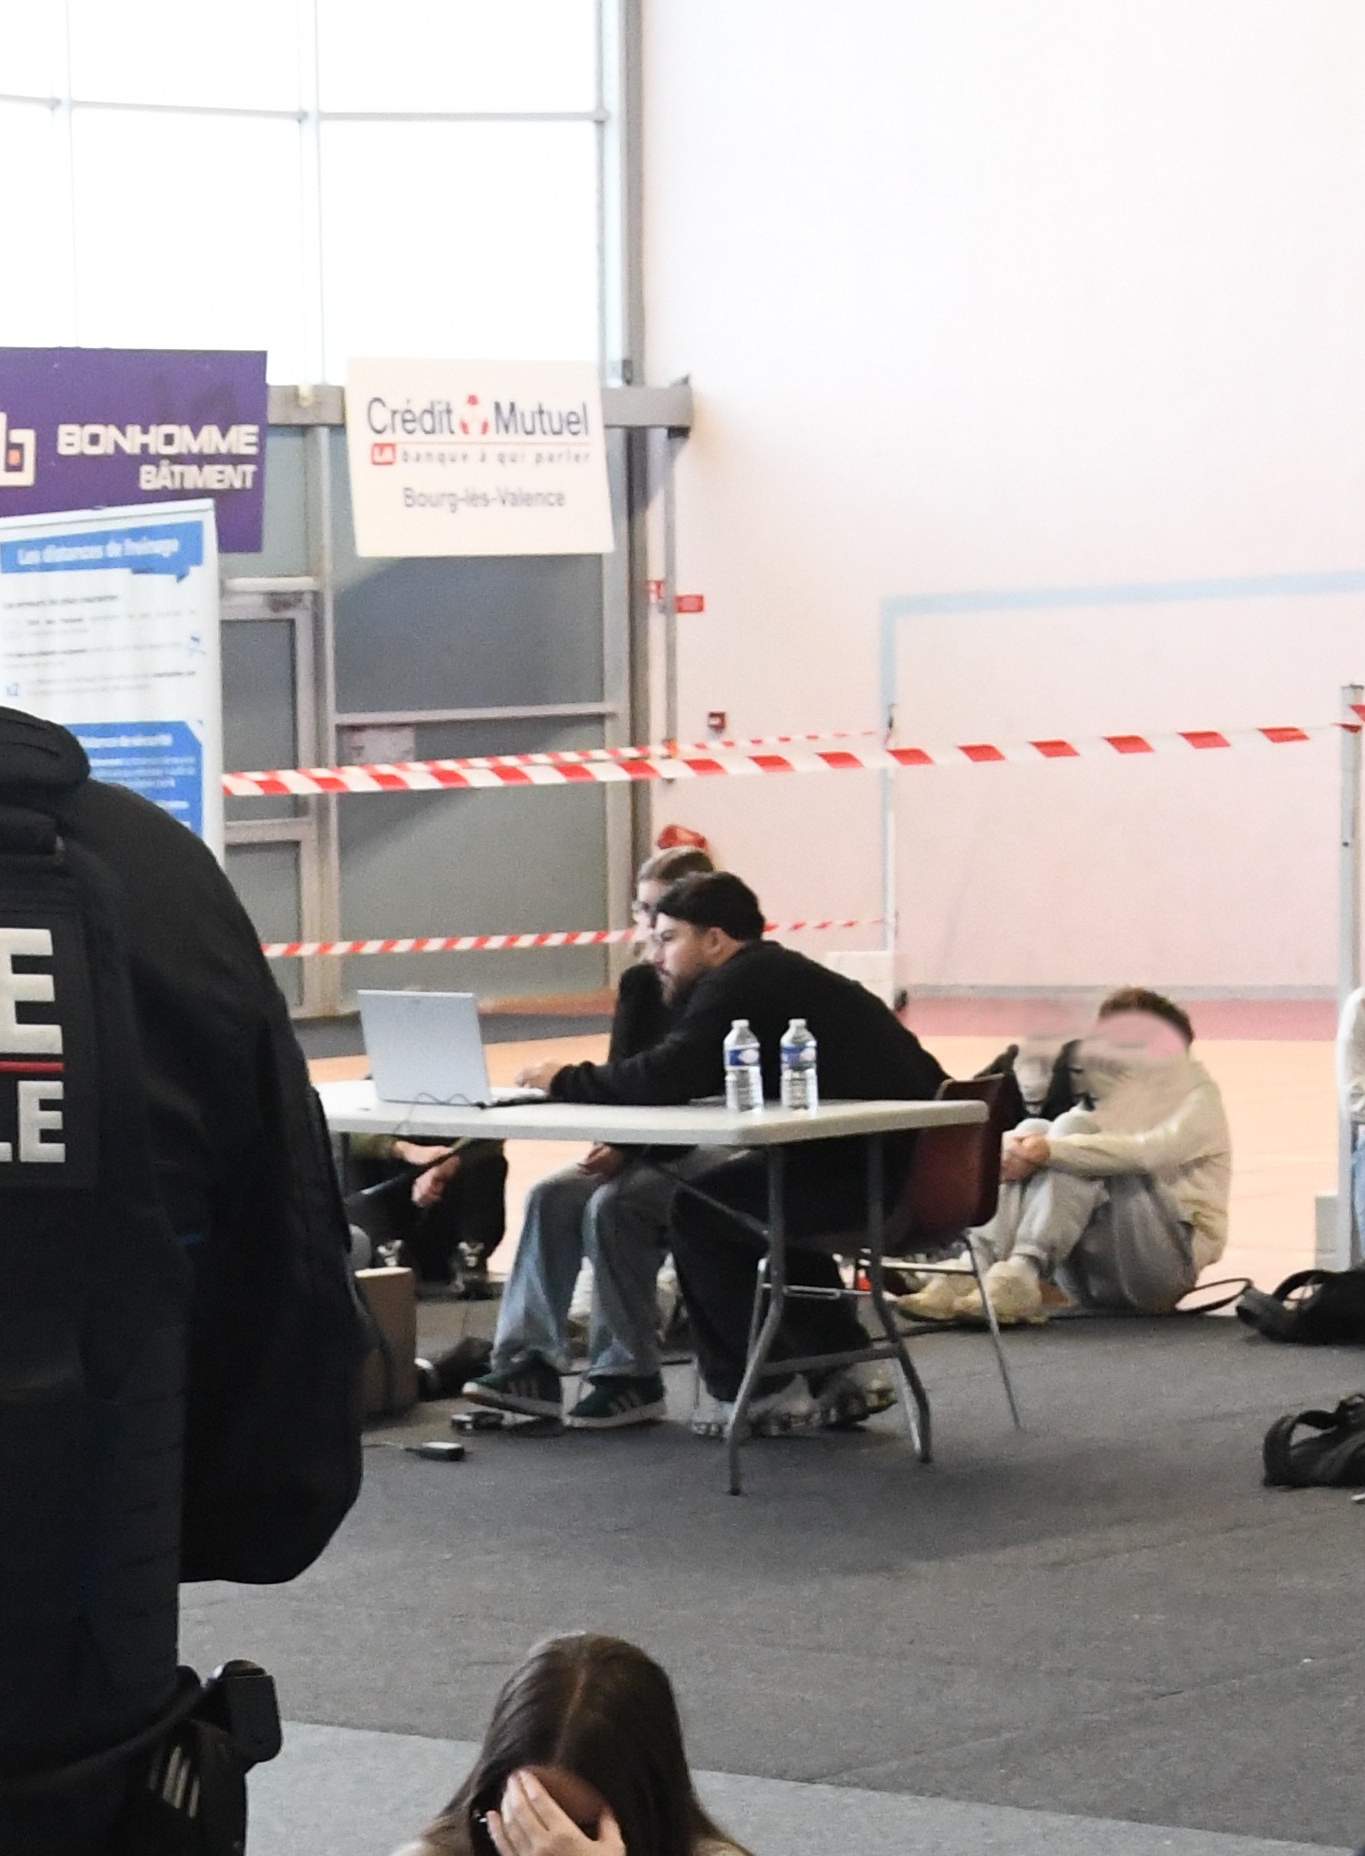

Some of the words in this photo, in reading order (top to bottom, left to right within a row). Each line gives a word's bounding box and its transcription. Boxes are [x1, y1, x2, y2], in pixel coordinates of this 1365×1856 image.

[366, 397, 456, 435] Crédit
[493, 401, 590, 436] Mutuel
[56, 423, 260, 456] BONHOMME
[139, 458, 257, 491] BÂTIMENT
